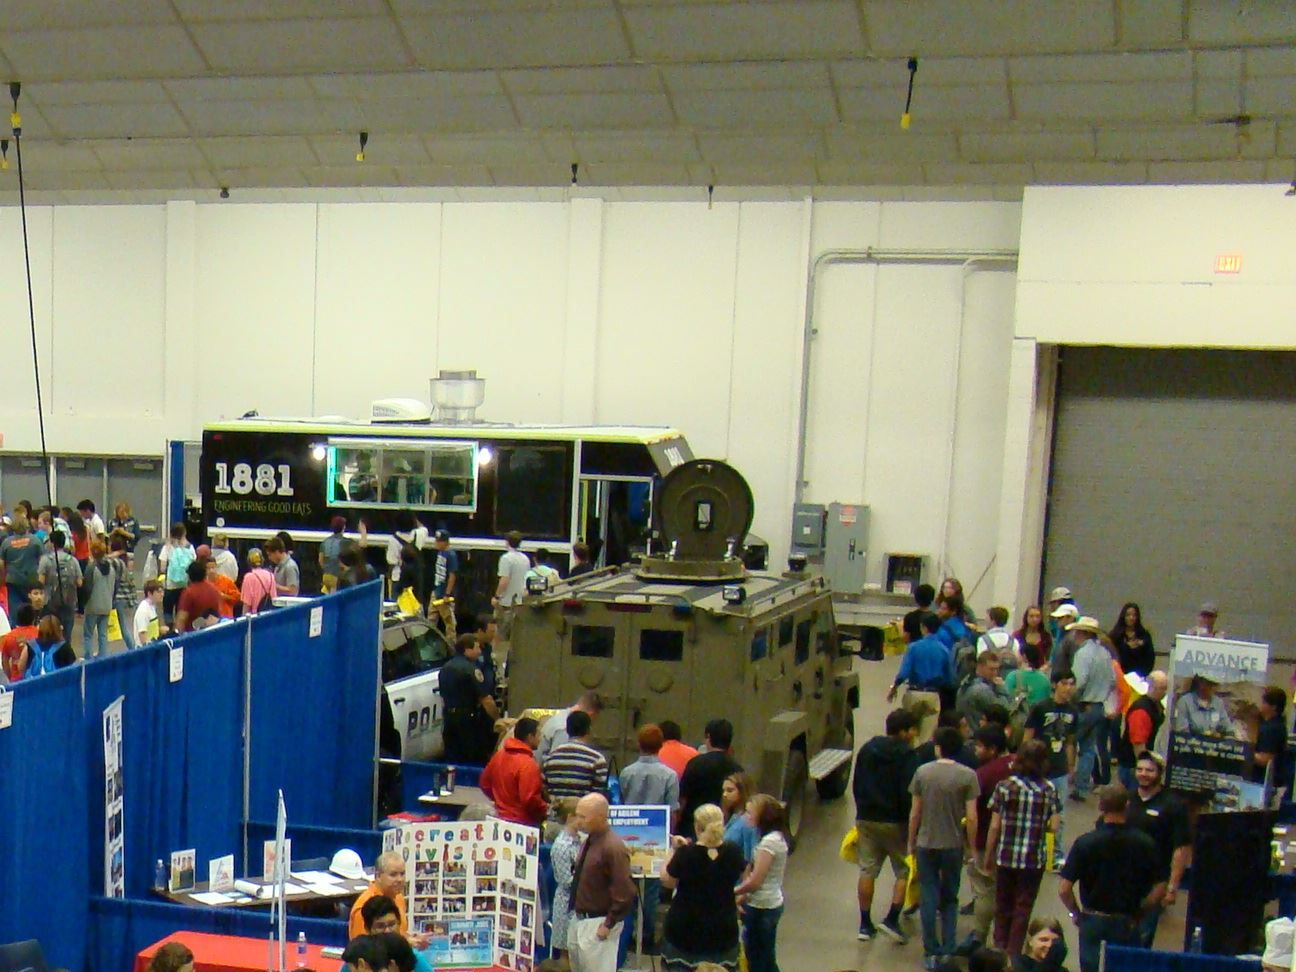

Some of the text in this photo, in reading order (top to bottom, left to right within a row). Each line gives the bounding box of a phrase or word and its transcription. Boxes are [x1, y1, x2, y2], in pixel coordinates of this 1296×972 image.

[1218, 256, 1241, 271] EXIT
[214, 463, 294, 496] 1881
[268, 501, 291, 513] GOOD
[1183, 650, 1258, 671] ADVANCE
[407, 704, 439, 738] POL
[396, 821, 524, 846] Recreation
[402, 842, 512, 863] Division
